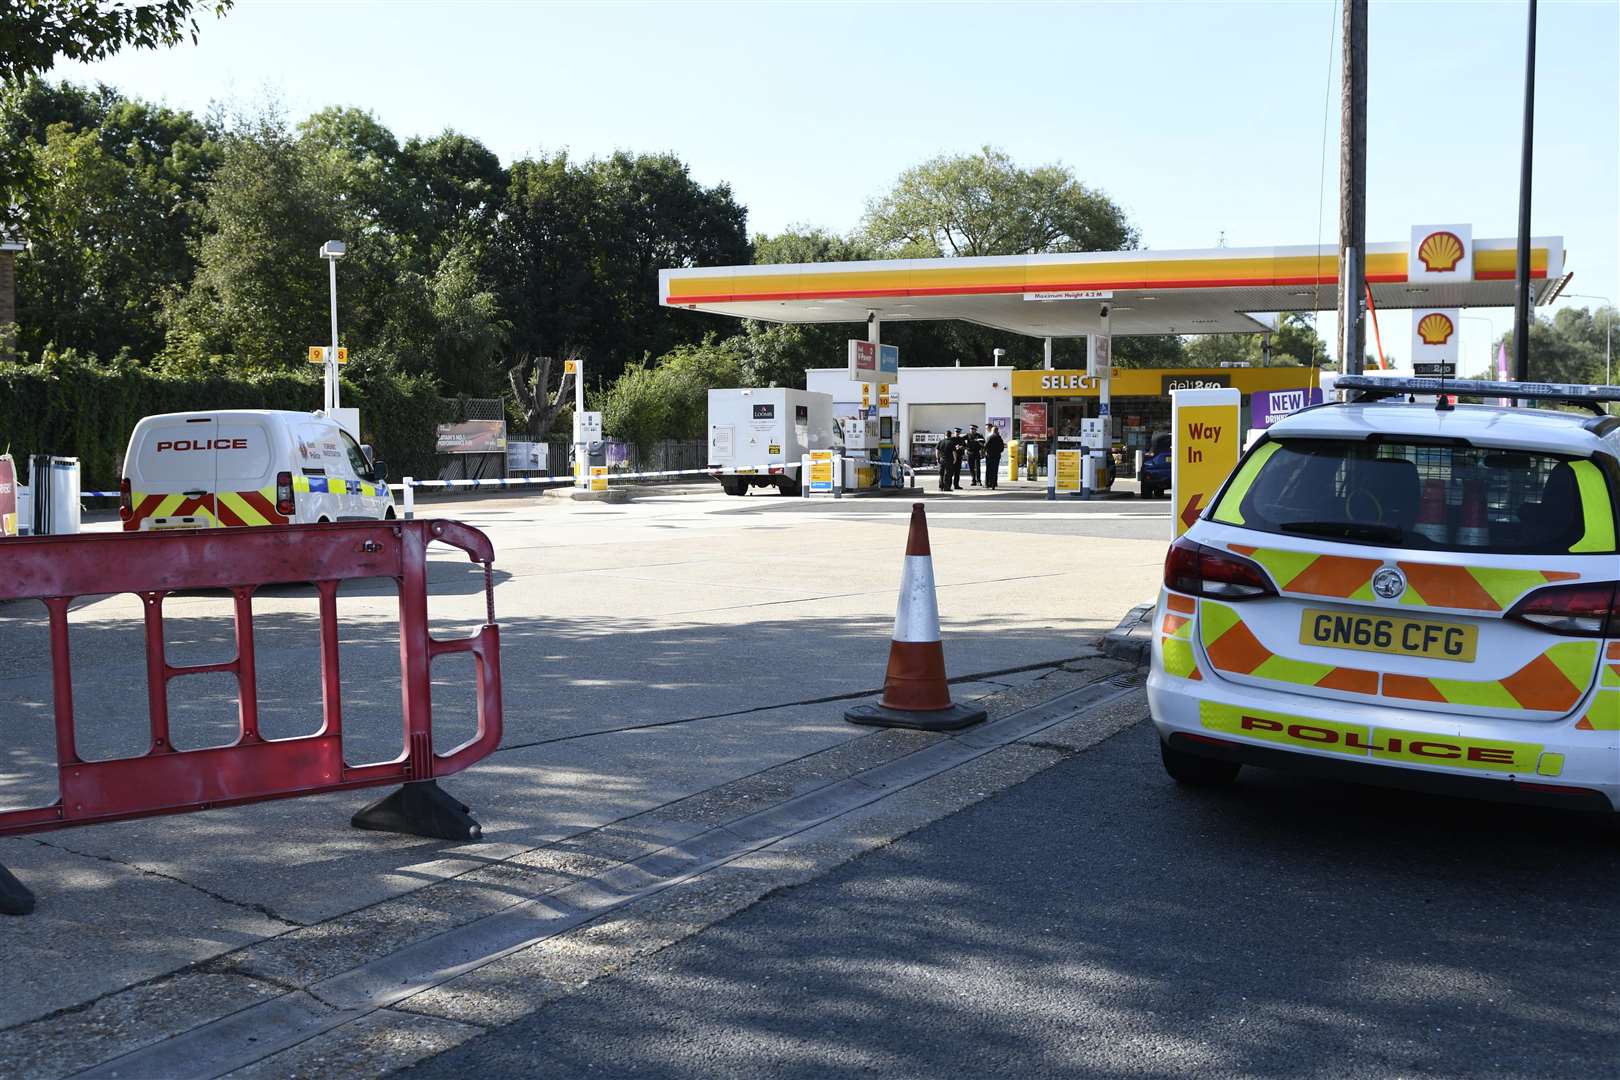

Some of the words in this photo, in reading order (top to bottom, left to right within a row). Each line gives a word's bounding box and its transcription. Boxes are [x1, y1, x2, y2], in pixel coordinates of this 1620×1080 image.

[314, 350, 320, 358] 9
[338, 351, 344, 359] 8
[1041, 375, 1098, 390] SELECT
[880, 398, 888, 406] 10
[1272, 394, 1301, 411] NEW
[1189, 422, 1222, 444] Way
[157, 438, 248, 453] POLICE
[1188, 446, 1202, 463] In
[1313, 614, 1392, 648] GN66
[1401, 623, 1464, 656] CFG
[1241, 715, 1515, 765] POLICE
